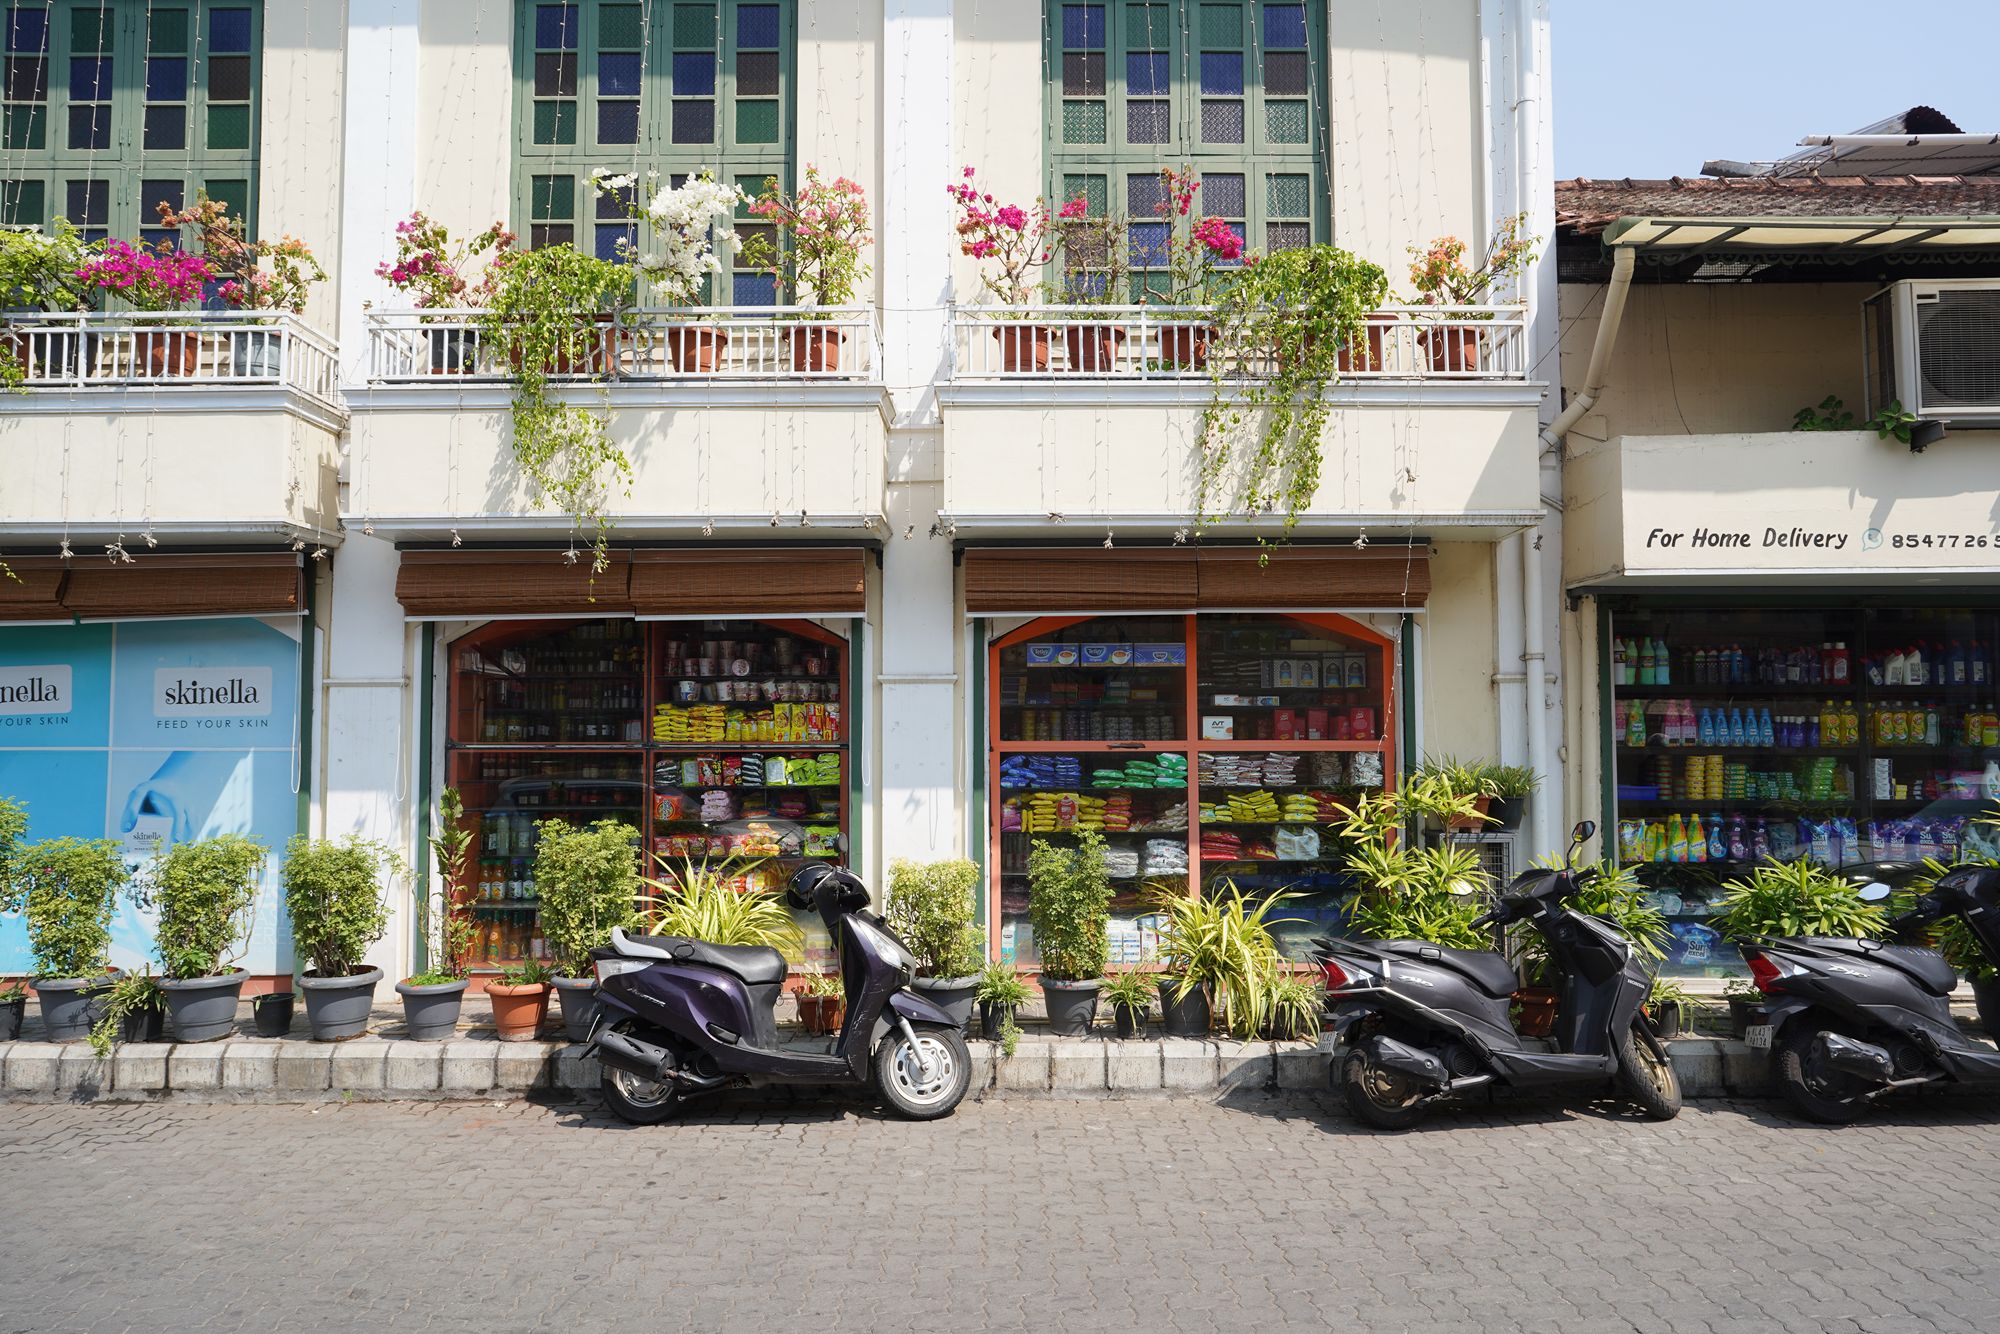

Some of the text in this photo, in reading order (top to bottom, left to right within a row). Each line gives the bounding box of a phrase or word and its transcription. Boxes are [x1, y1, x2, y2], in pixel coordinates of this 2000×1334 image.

[1646, 528, 1685, 548] For
[1691, 528, 1751, 548] Home
[1762, 527, 1849, 550] Delivery
[0, 677, 60, 704] nella
[165, 678, 259, 705] skinella
[39, 716, 69, 726] SKIN
[156, 719, 269, 729] FEED YOUR SKIN
[1627, 978, 1646, 990] HONDA
